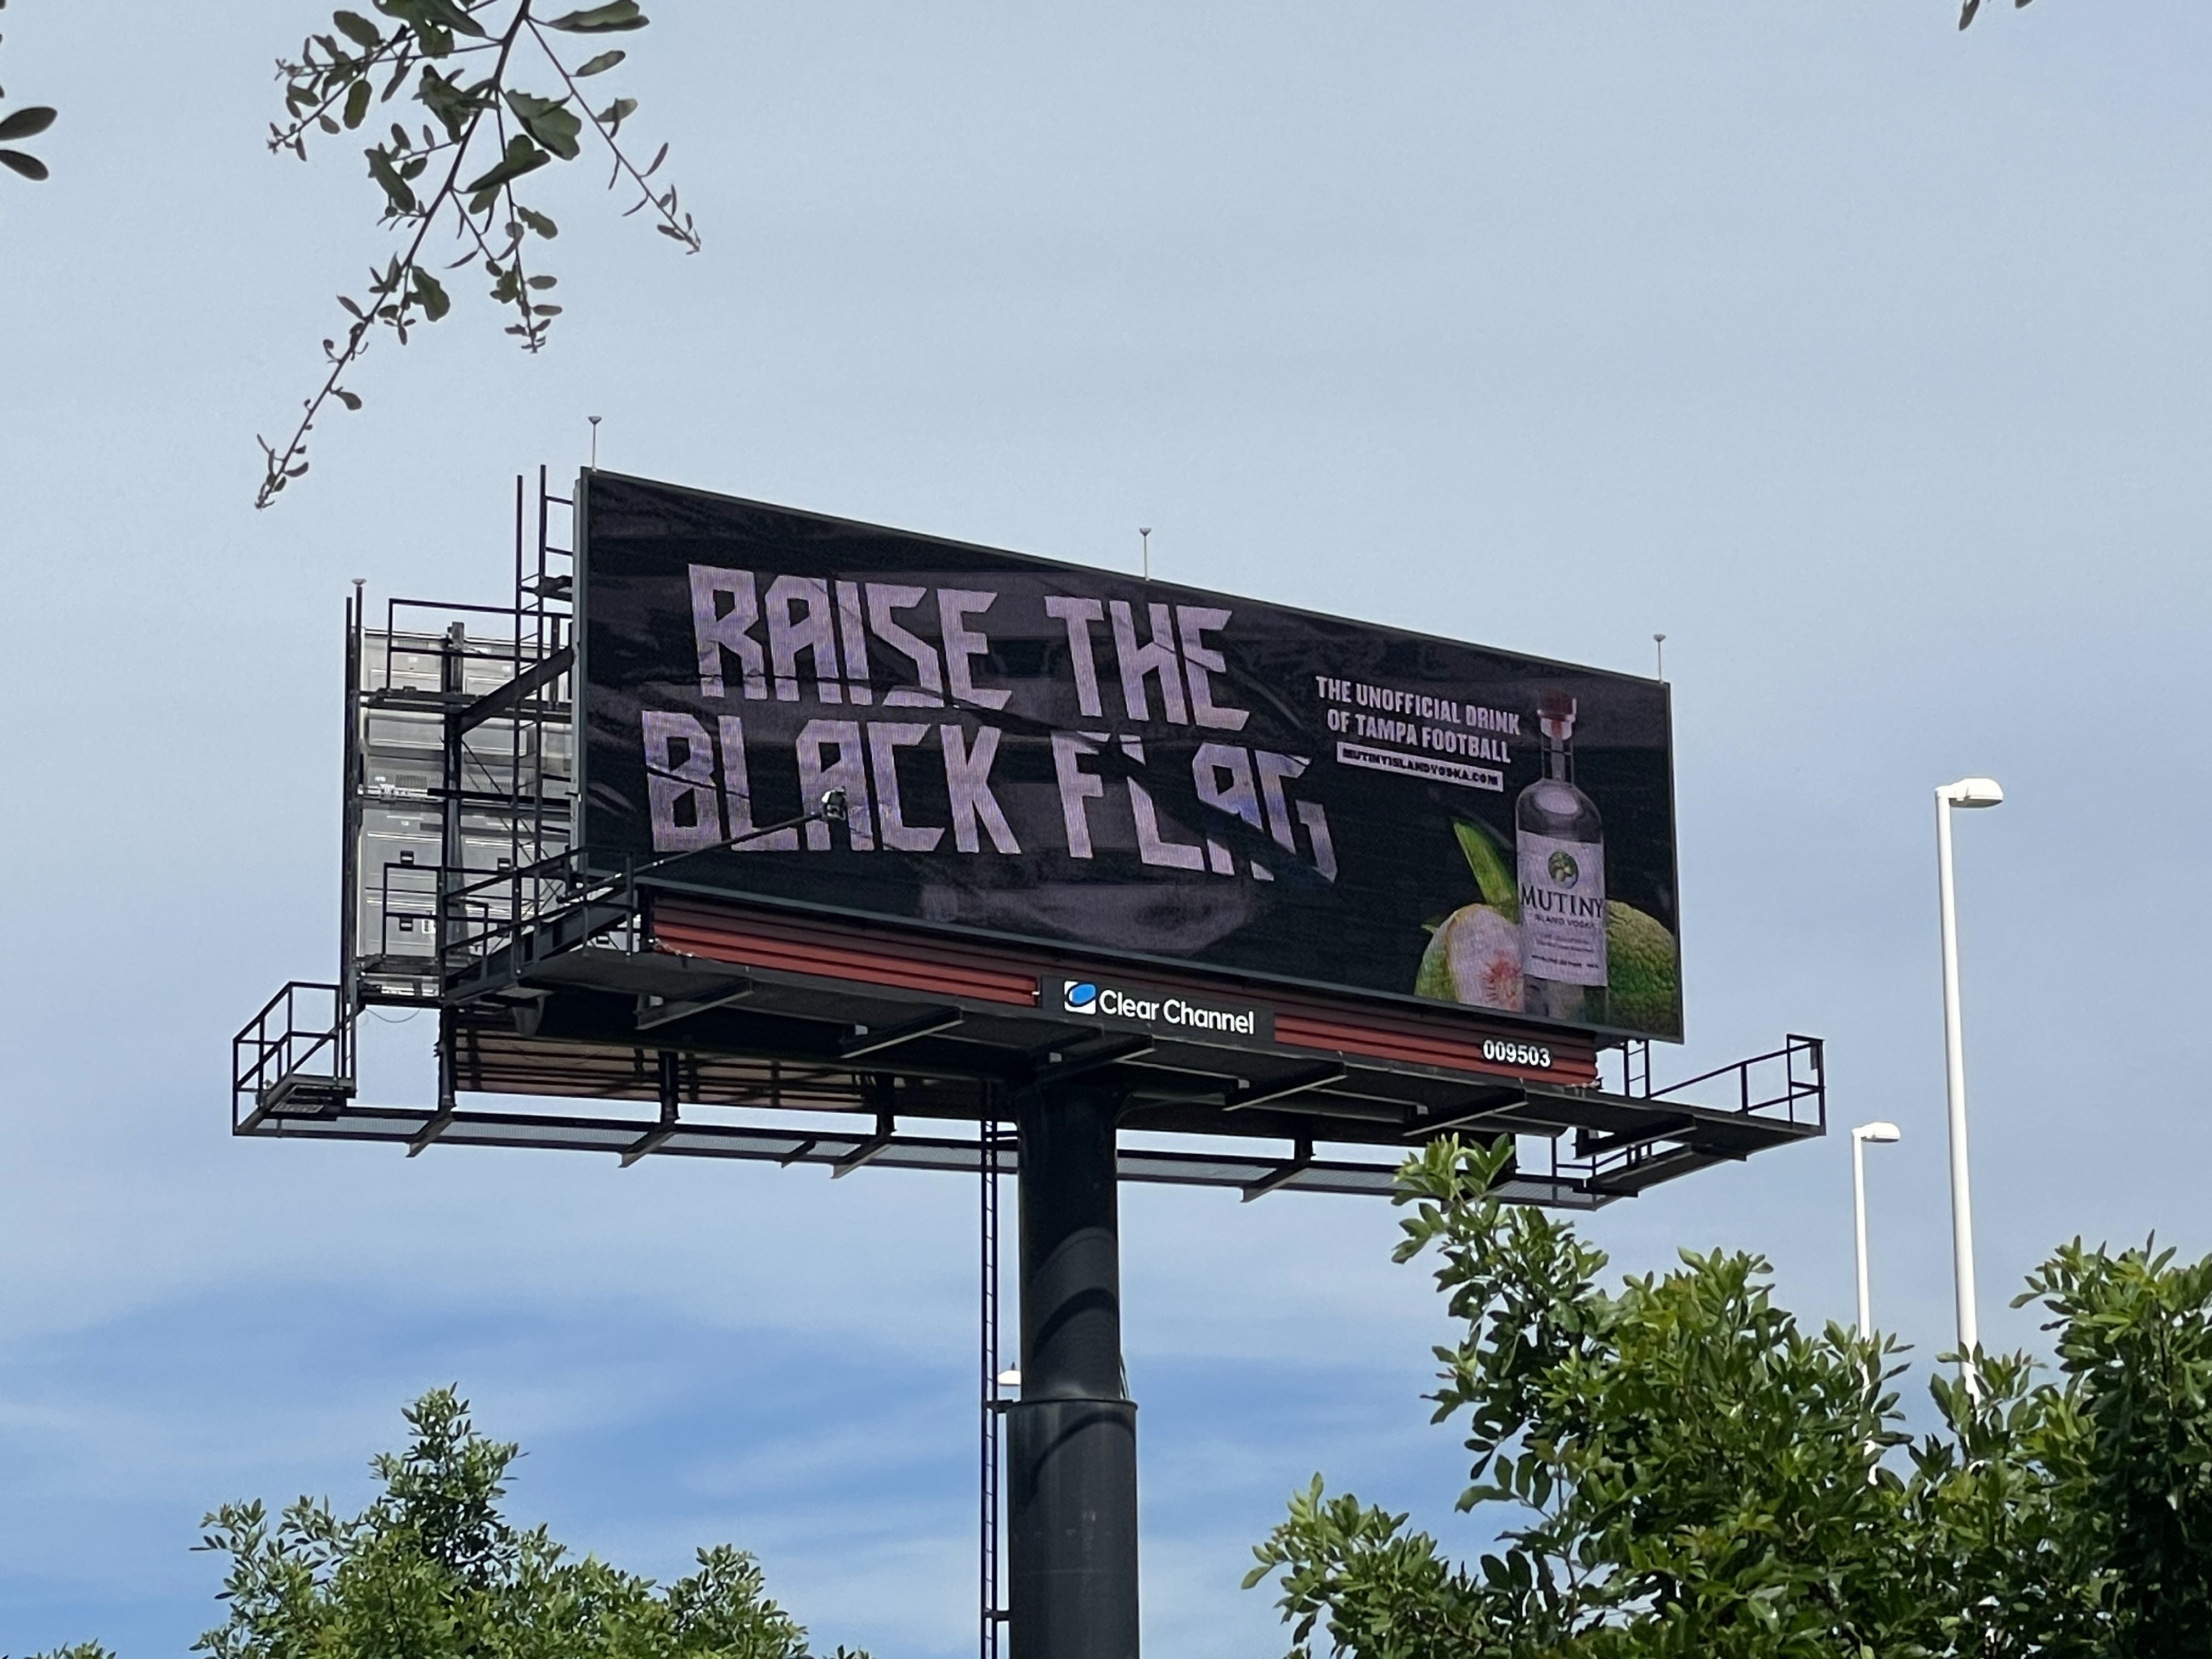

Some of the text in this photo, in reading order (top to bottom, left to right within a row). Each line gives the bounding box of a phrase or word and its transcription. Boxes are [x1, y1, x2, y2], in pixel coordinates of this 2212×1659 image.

[688, 563, 1250, 731] RAISE THE
[1316, 675, 1521, 736] THE UNOFFICIAL DRINK
[1327, 708, 1511, 764] OF TAMPA FOOTBALL
[1342, 748, 1499, 786] MUTINYISLANDVODKA.COM
[641, 710, 1338, 884] BLACK FLAG
[1520, 884, 1604, 918] MUTINY
[1099, 990, 1254, 1035] Clear Channel
[1483, 1039, 1551, 1068] 009503
